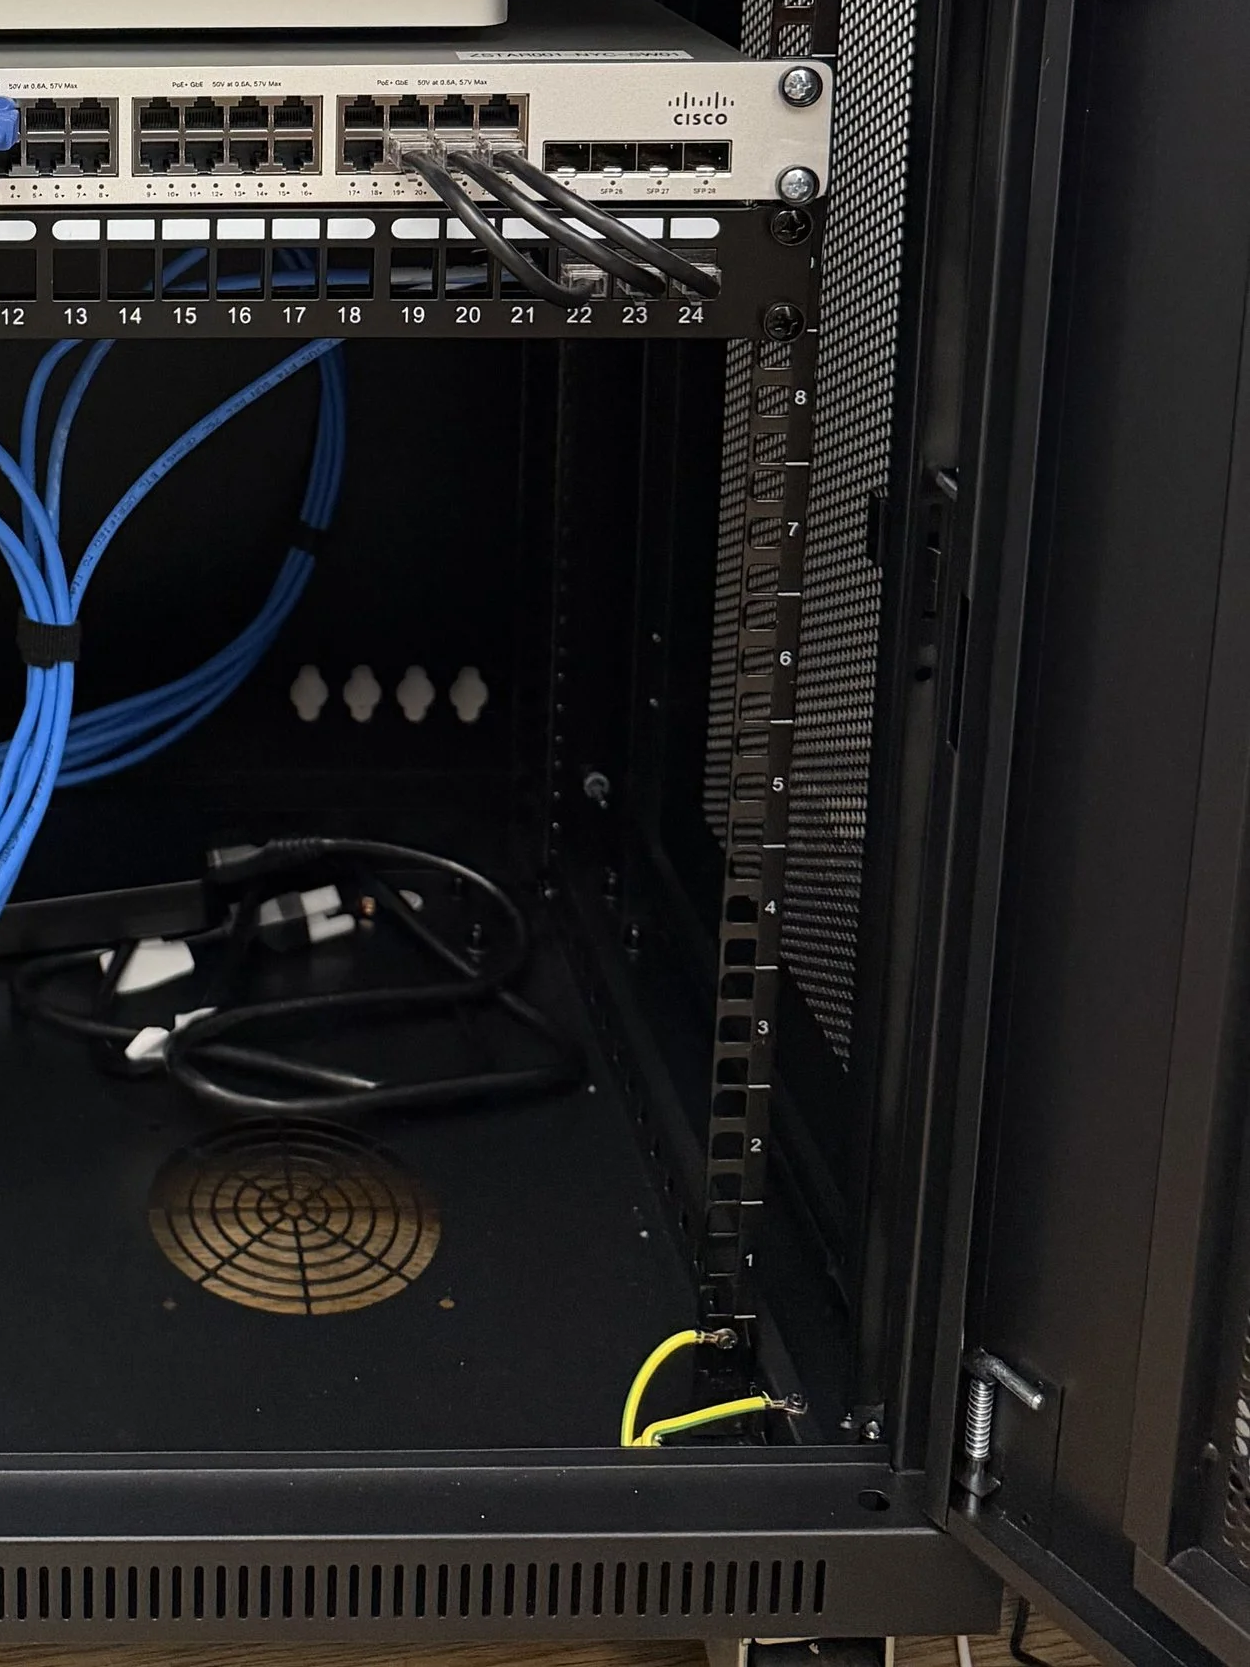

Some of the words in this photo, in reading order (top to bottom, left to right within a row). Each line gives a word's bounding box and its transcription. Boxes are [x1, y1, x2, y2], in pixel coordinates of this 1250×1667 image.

[674, 114, 727, 125] CISCO
[2, 308, 24, 325] 12
[65, 308, 87, 324] 13
[119, 308, 141, 324] 14
[174, 308, 196, 324] 15
[229, 307, 251, 323] 16
[283, 307, 306, 323] 17
[338, 307, 360, 323] 18
[402, 307, 424, 323] 19
[456, 307, 480, 323] 20
[511, 307, 533, 323] 21
[566, 307, 592, 324] 22
[623, 307, 647, 323] 23
[679, 307, 703, 323] 24
[795, 390, 806, 404] 8
[788, 522, 798, 536] 7
[780, 651, 791, 665] 6
[773, 778, 783, 791] 5
[765, 901, 775, 913] 4
[758, 1021, 768, 1034] 3
[751, 1139, 761, 1151] 2
[746, 1254, 752, 1266] 1
